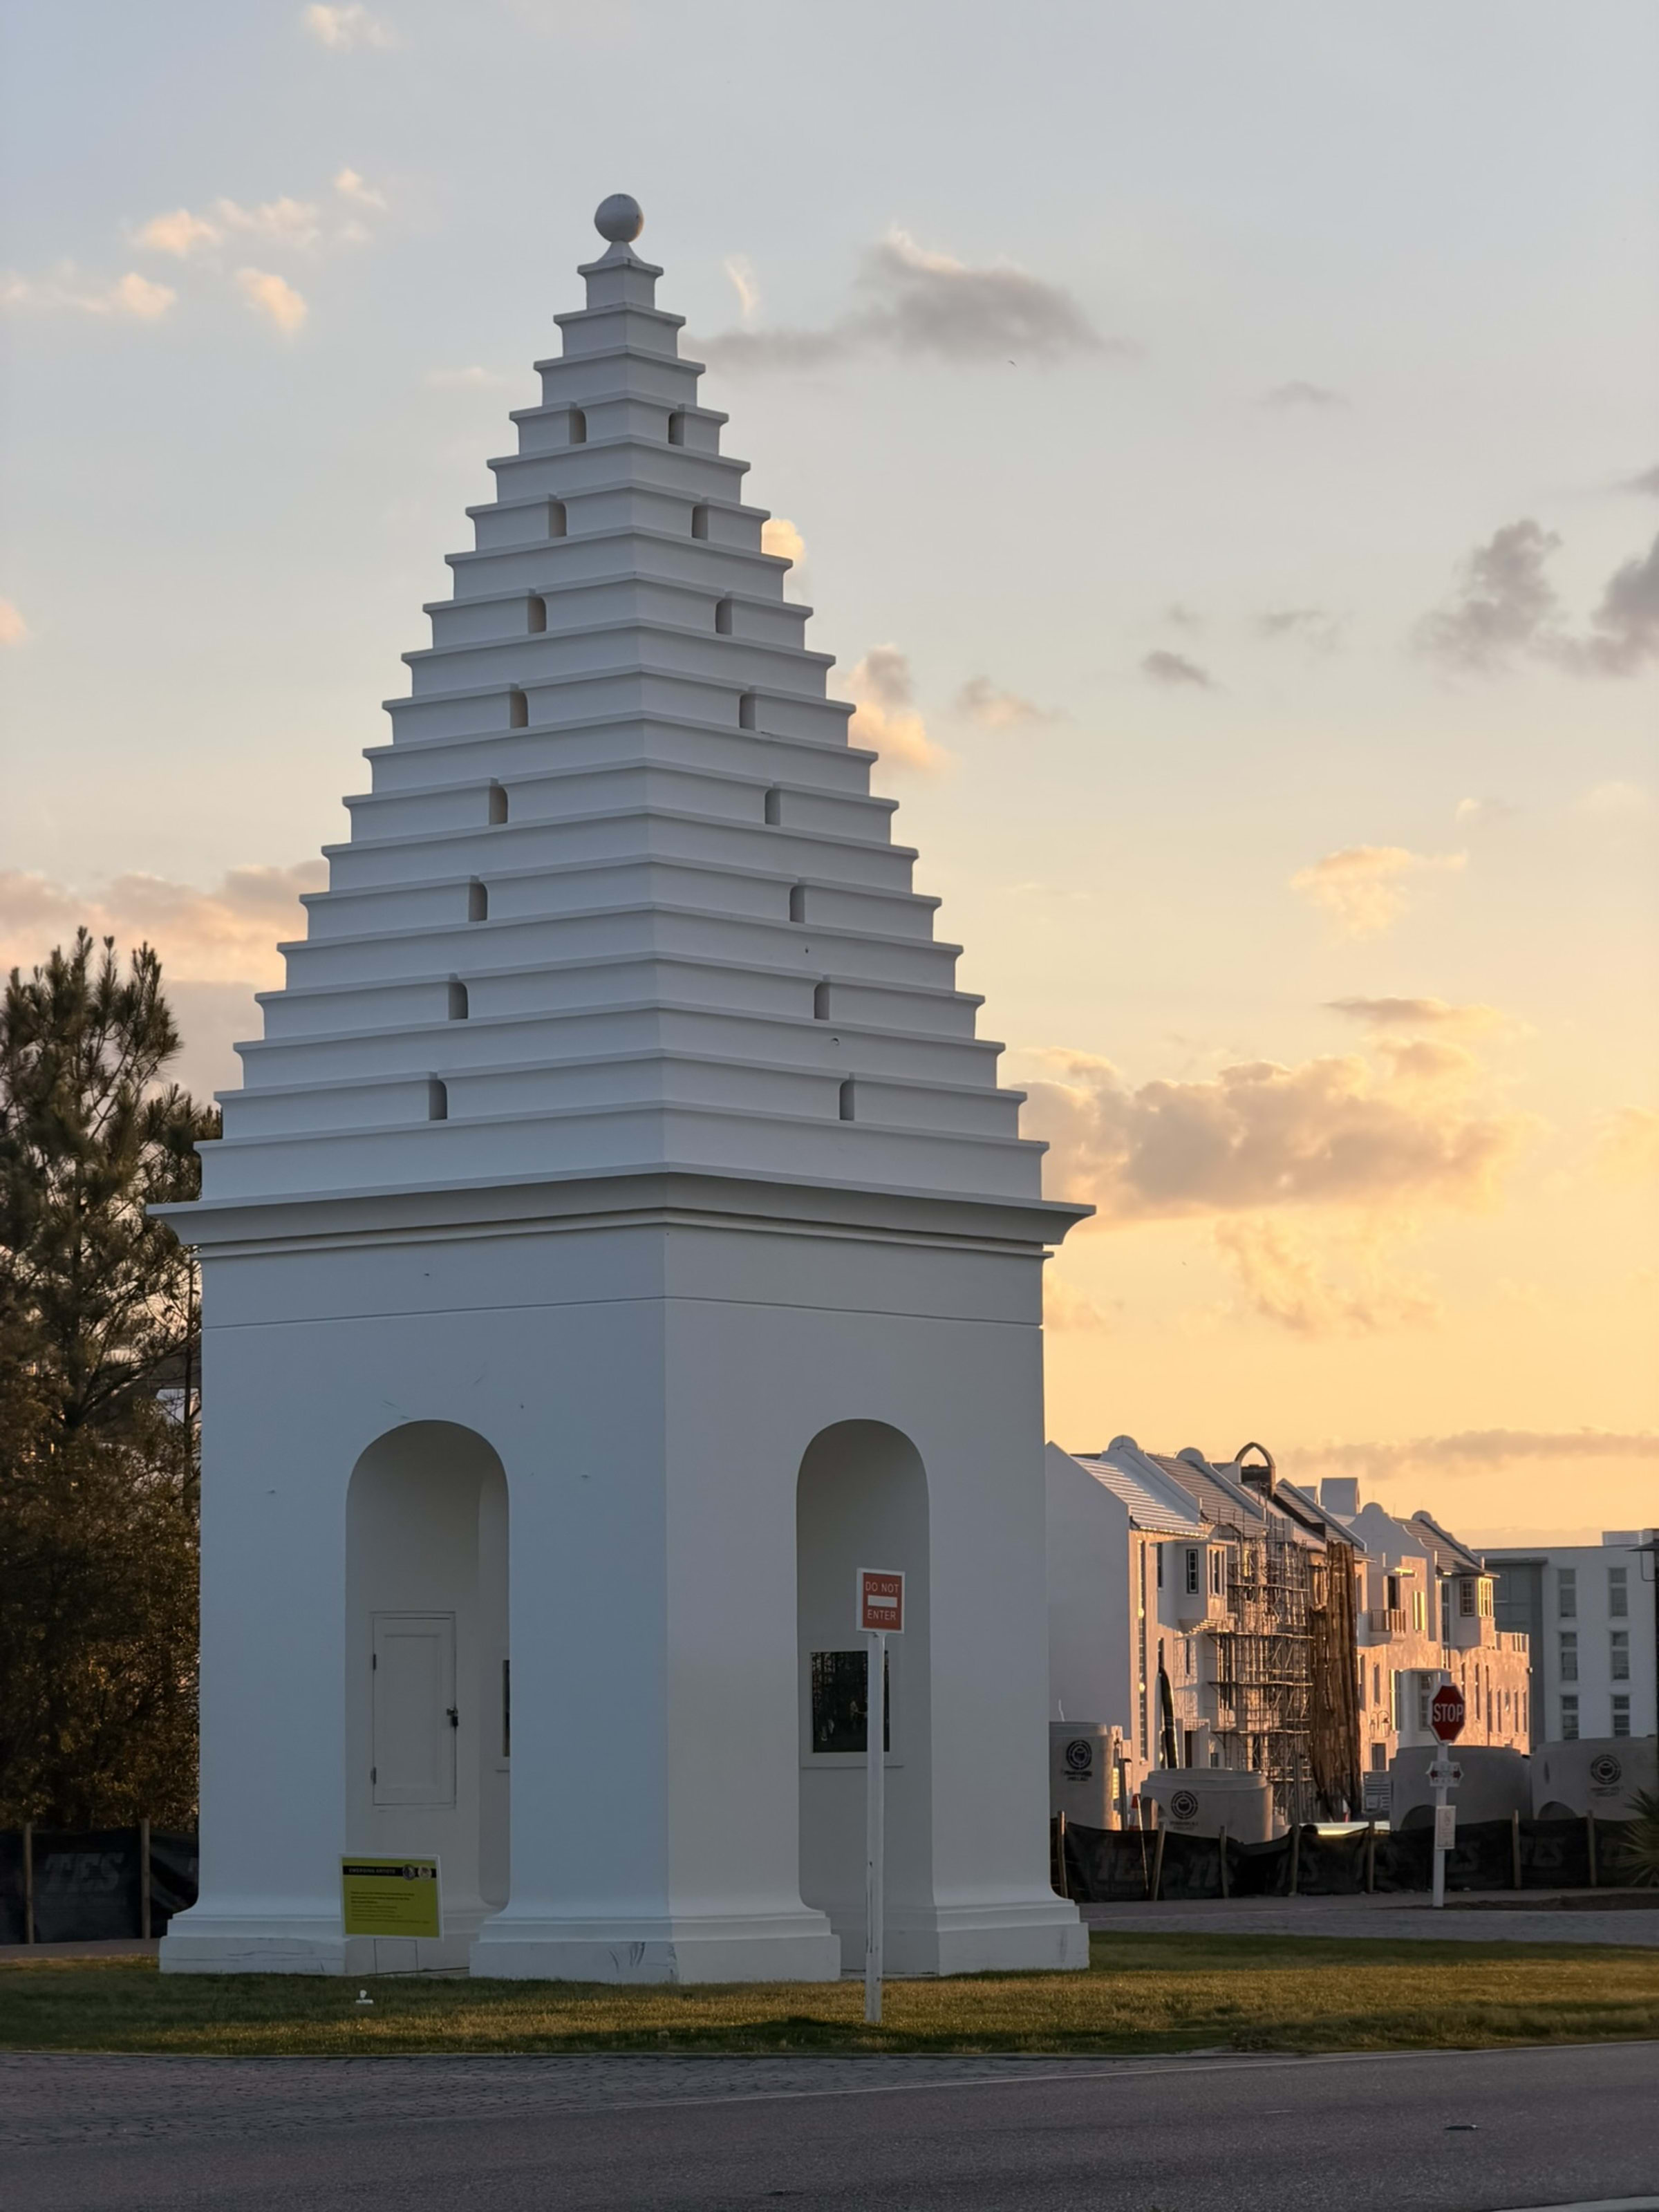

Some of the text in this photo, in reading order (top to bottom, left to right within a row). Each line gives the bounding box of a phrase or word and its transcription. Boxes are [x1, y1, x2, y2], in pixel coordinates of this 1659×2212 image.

[865, 1581, 899, 1593] DO NOT
[868, 1609, 897, 1620] ENTER
[1434, 1703, 1463, 1722] STOP
